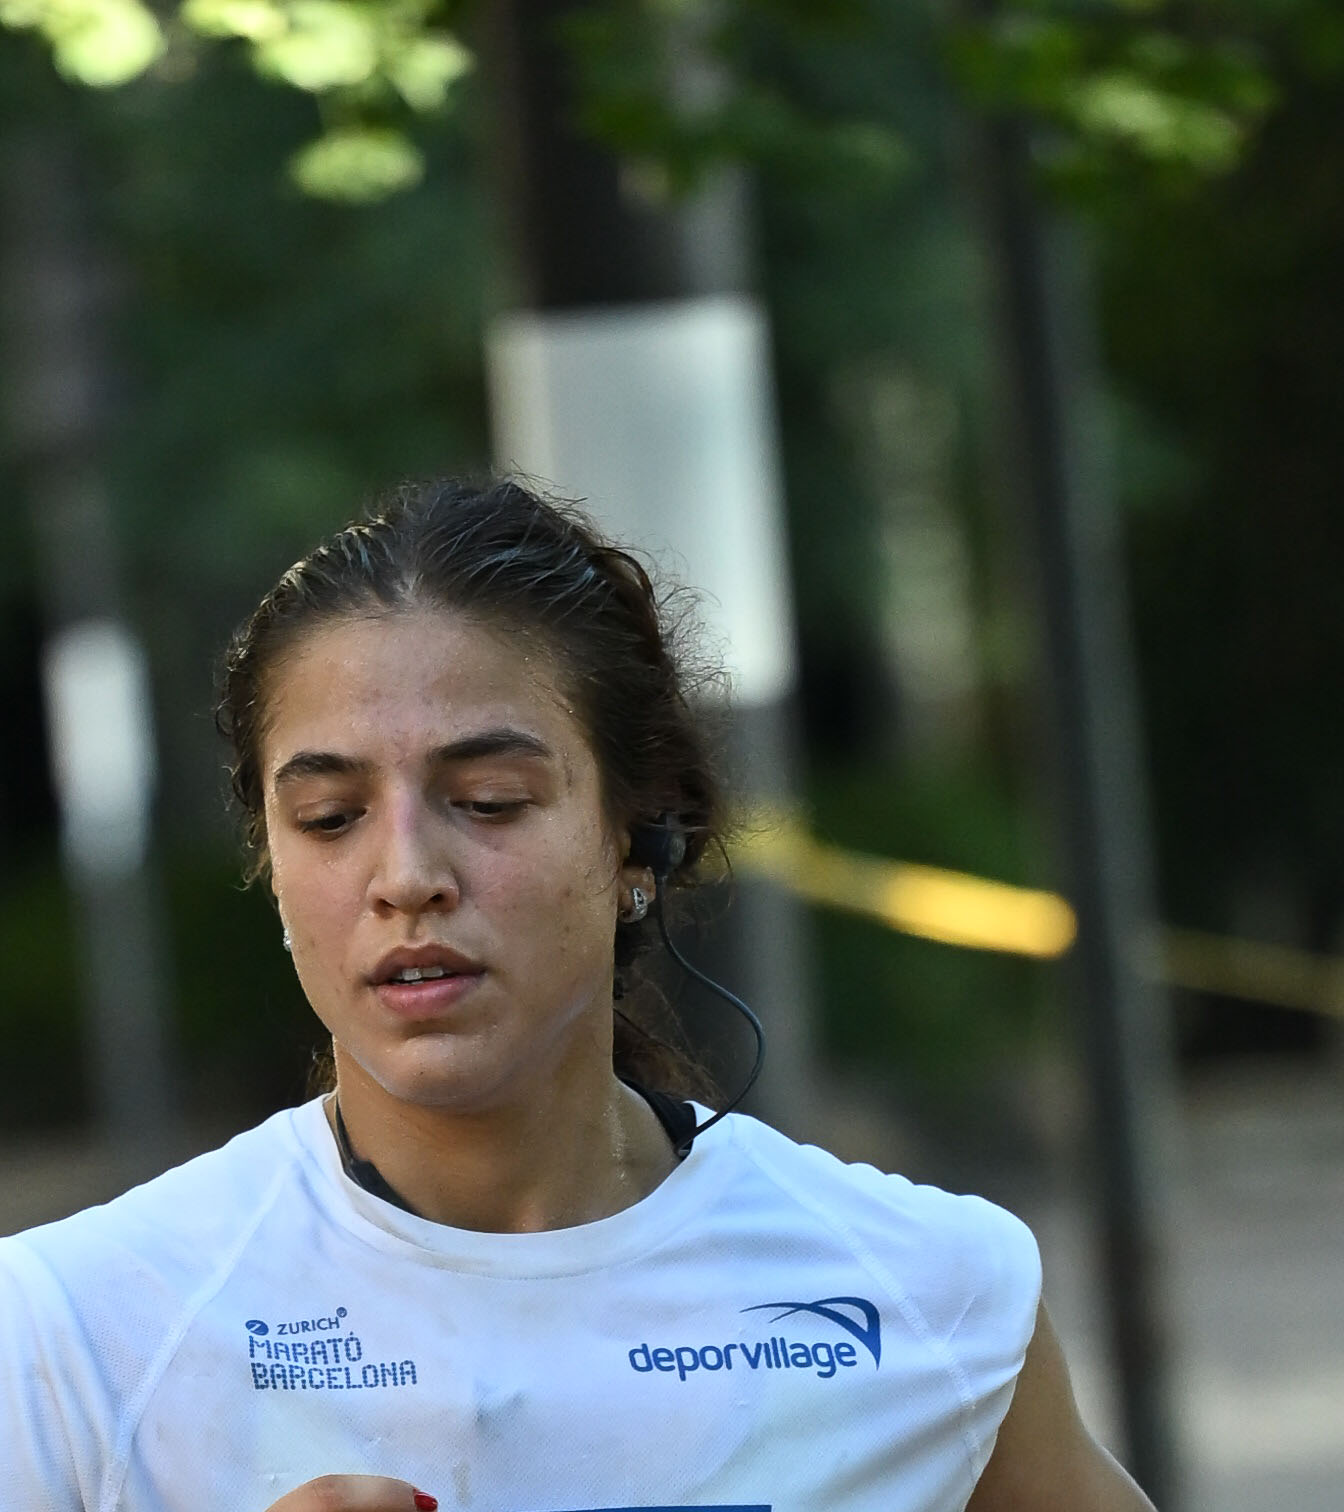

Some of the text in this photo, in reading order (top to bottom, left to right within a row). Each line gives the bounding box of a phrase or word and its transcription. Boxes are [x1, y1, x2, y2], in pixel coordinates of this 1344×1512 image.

[249, 1331, 362, 1365] MARATÓ
[629, 1337, 857, 1381] deporvillage
[251, 1360, 417, 1390] BARCELONA
